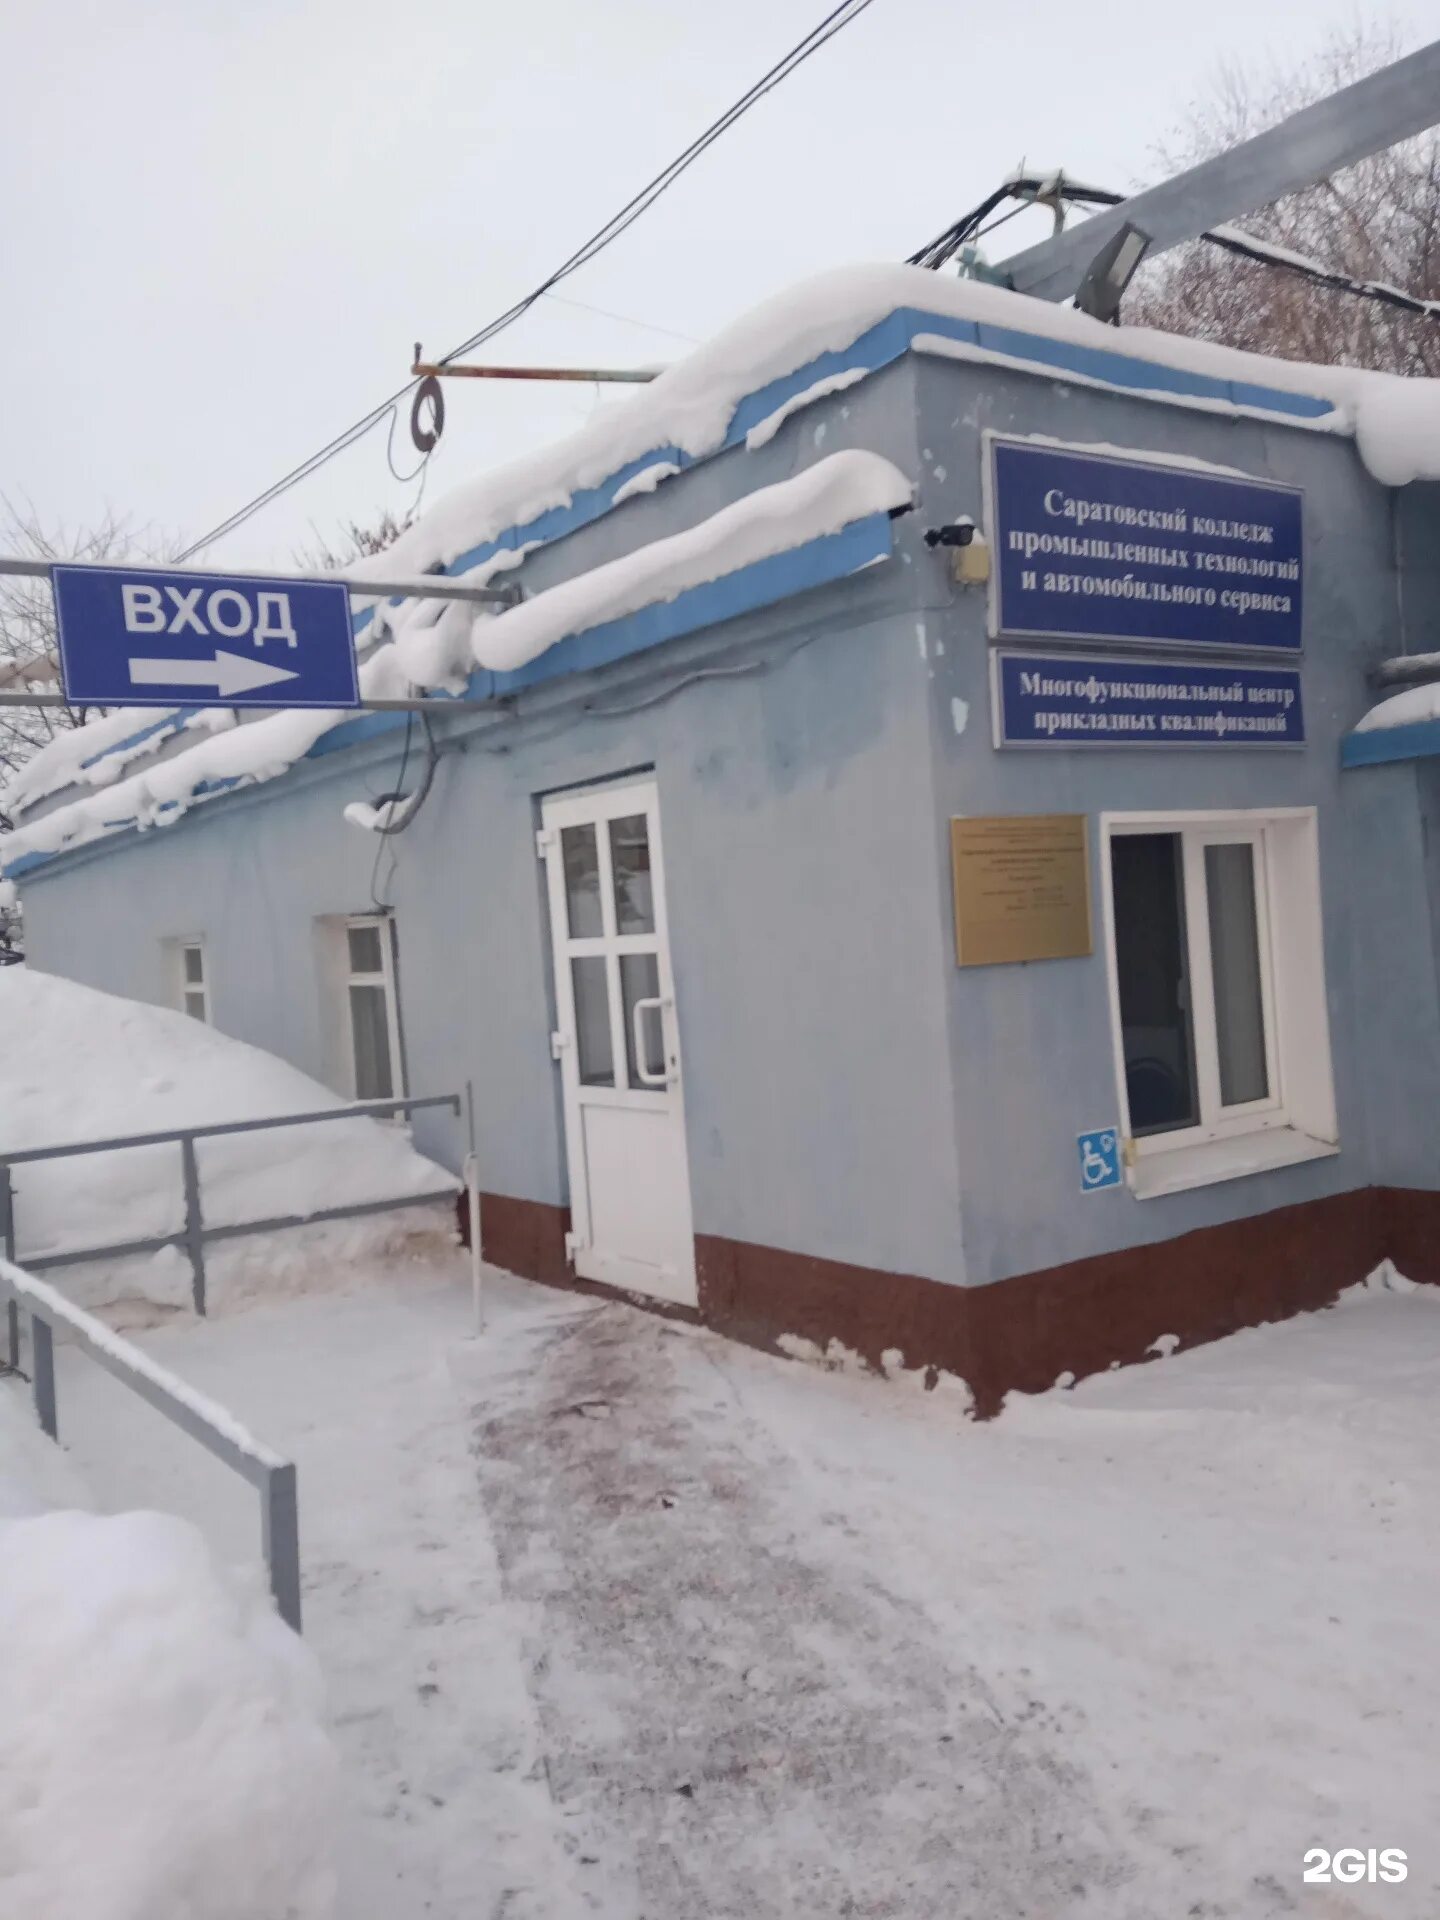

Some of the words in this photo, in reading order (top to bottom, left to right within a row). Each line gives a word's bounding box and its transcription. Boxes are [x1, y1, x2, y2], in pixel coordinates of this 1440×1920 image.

[1044, 488, 1187, 533] Саратовский
[1193, 514, 1274, 544] колледж
[1008, 530, 1189, 569] промышленных
[1194, 550, 1299, 581] технологий
[121, 584, 298, 648] ВХОД
[1021, 570, 1037, 590] и
[1044, 572, 1217, 606] автомобильного
[1220, 588, 1292, 615] сервиса
[1019, 671, 1244, 704] Многофункциональный
[1248, 687, 1295, 709] центр
[1034, 711, 1157, 736] прикладных
[1161, 710, 1288, 737] квалификаций
